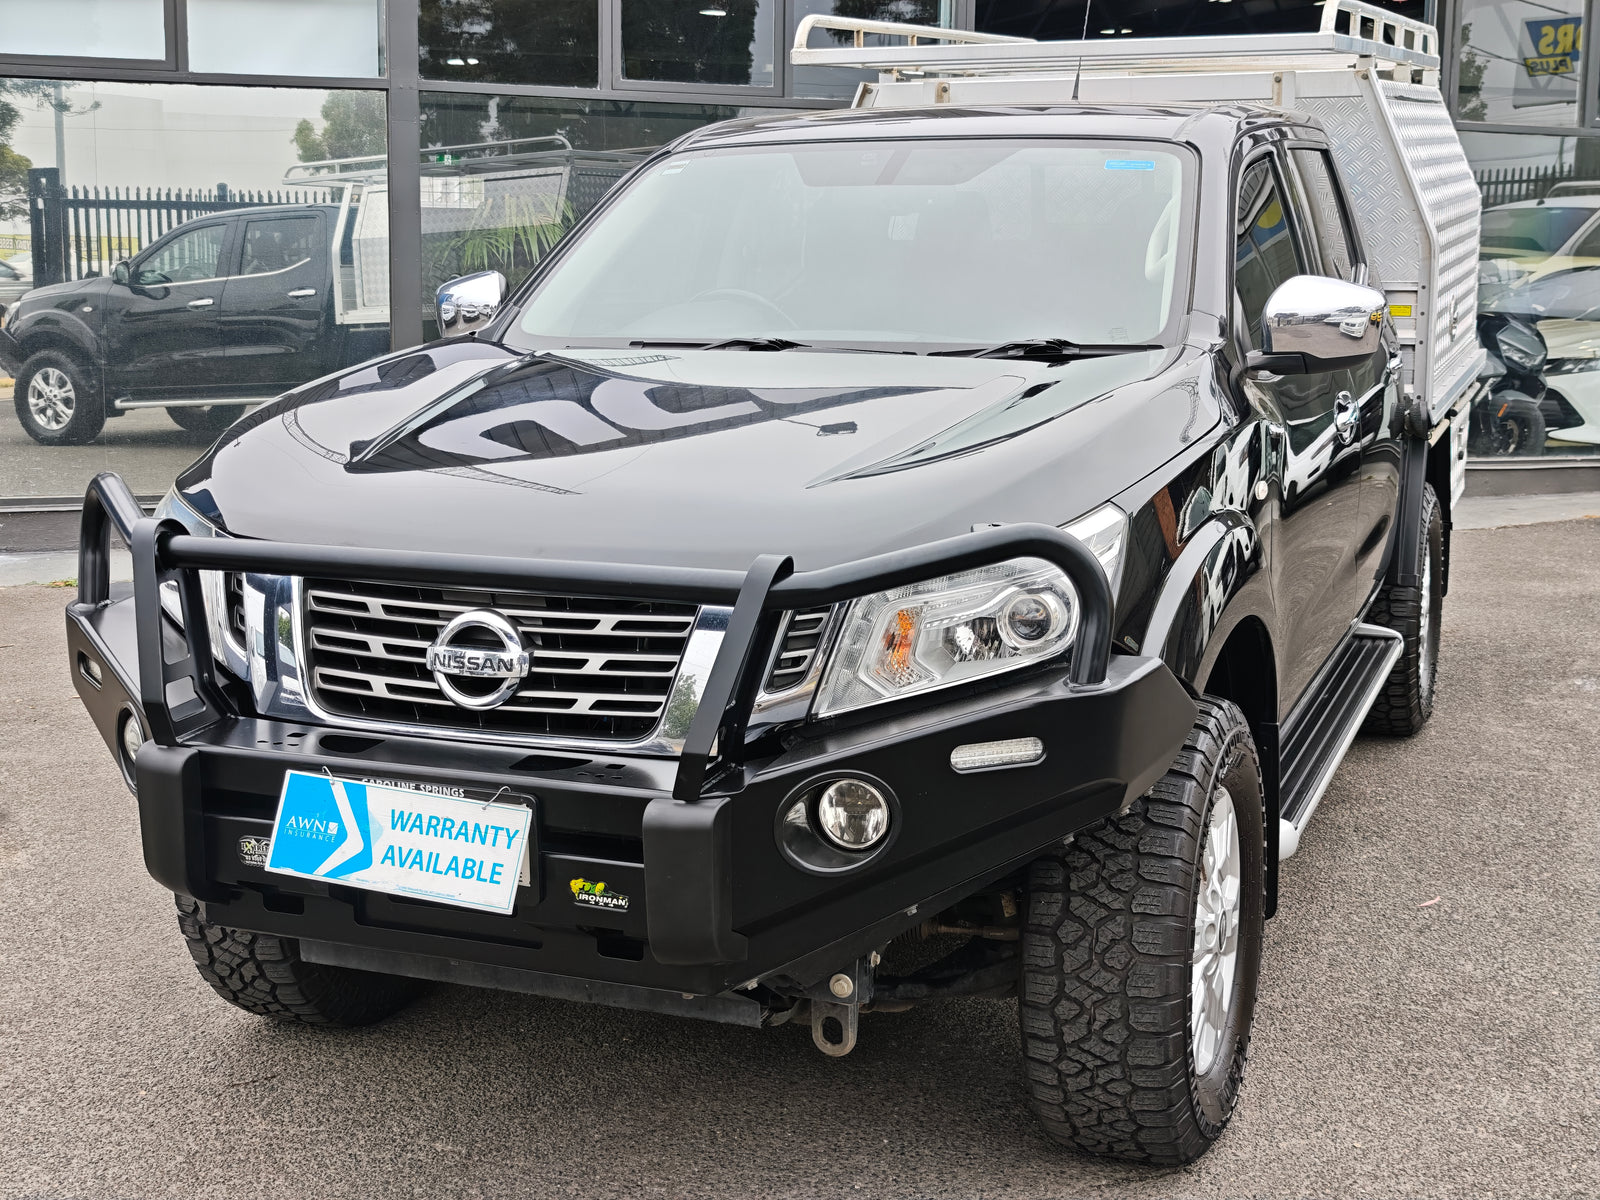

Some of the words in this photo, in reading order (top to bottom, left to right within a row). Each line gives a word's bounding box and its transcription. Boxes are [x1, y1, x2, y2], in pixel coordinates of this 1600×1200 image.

[433, 652, 514, 673] NISSAN
[420, 784, 465, 798] SPRINGS
[285, 815, 327, 833] AWN
[390, 808, 521, 850] WARRANTY
[283, 828, 335, 843] INSURANCE
[380, 844, 505, 885] AVAILABLE
[579, 893, 627, 906] IRONMAN
